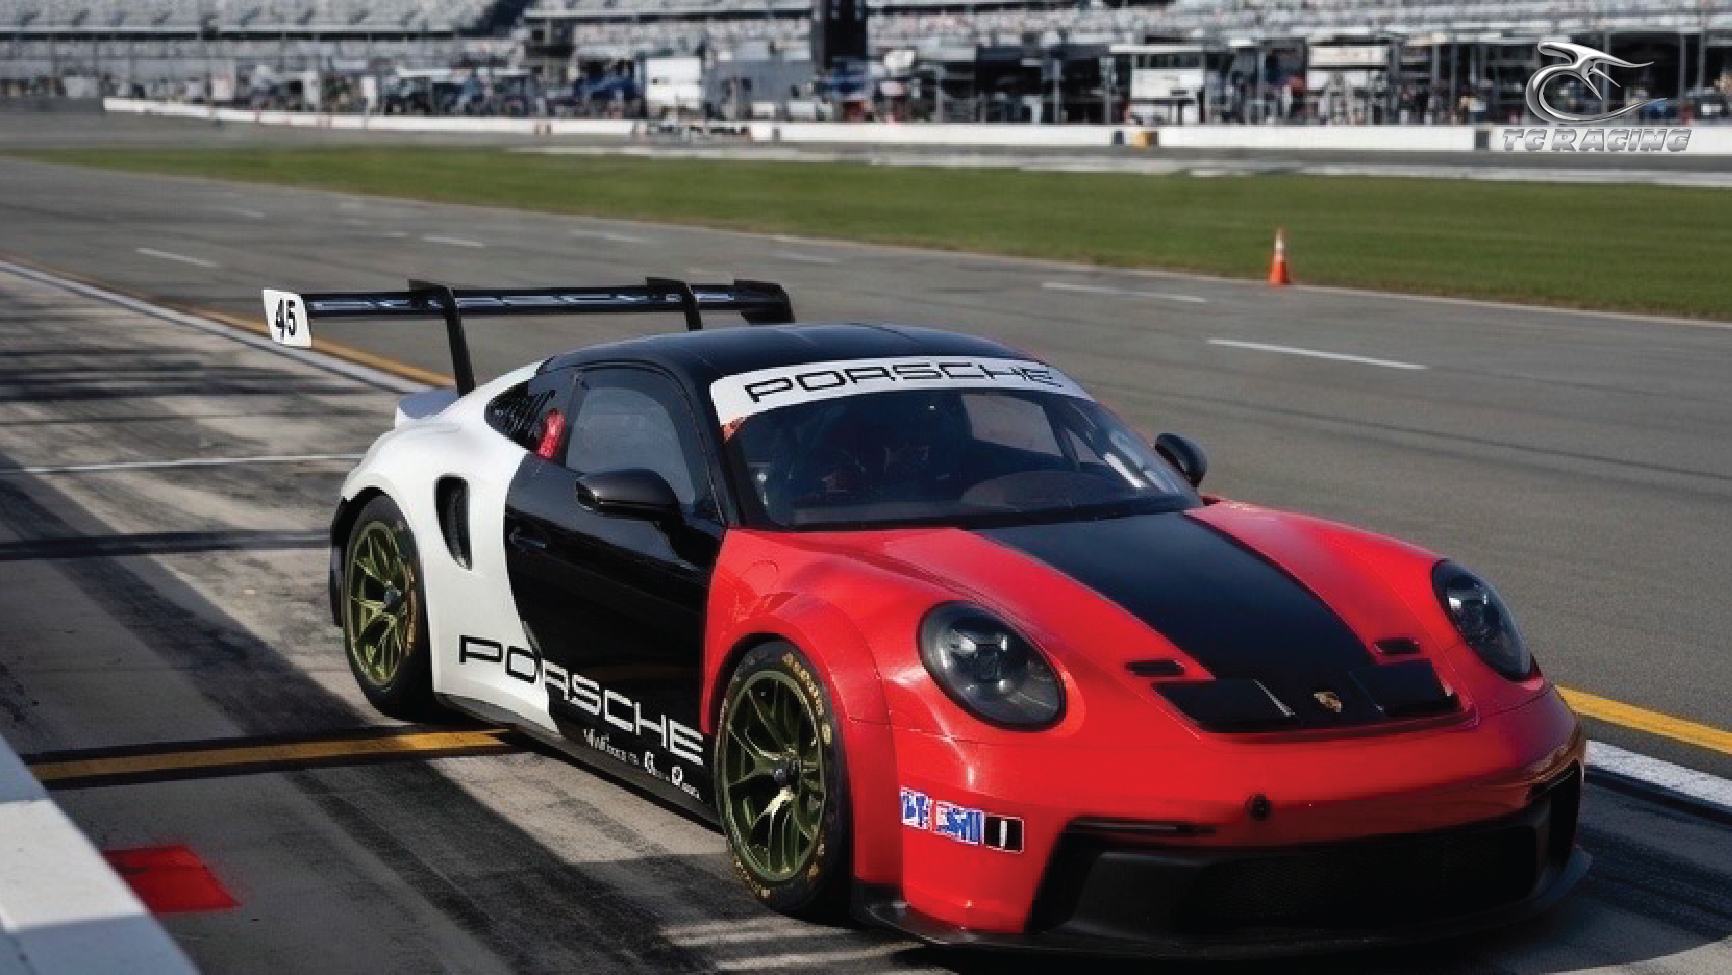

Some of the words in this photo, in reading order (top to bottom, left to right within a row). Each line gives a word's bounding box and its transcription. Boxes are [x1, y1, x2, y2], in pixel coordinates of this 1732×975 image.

[275, 298, 297, 338] 45
[745, 361, 1064, 402] PORSCHE
[459, 634, 704, 765] PORSCHE
